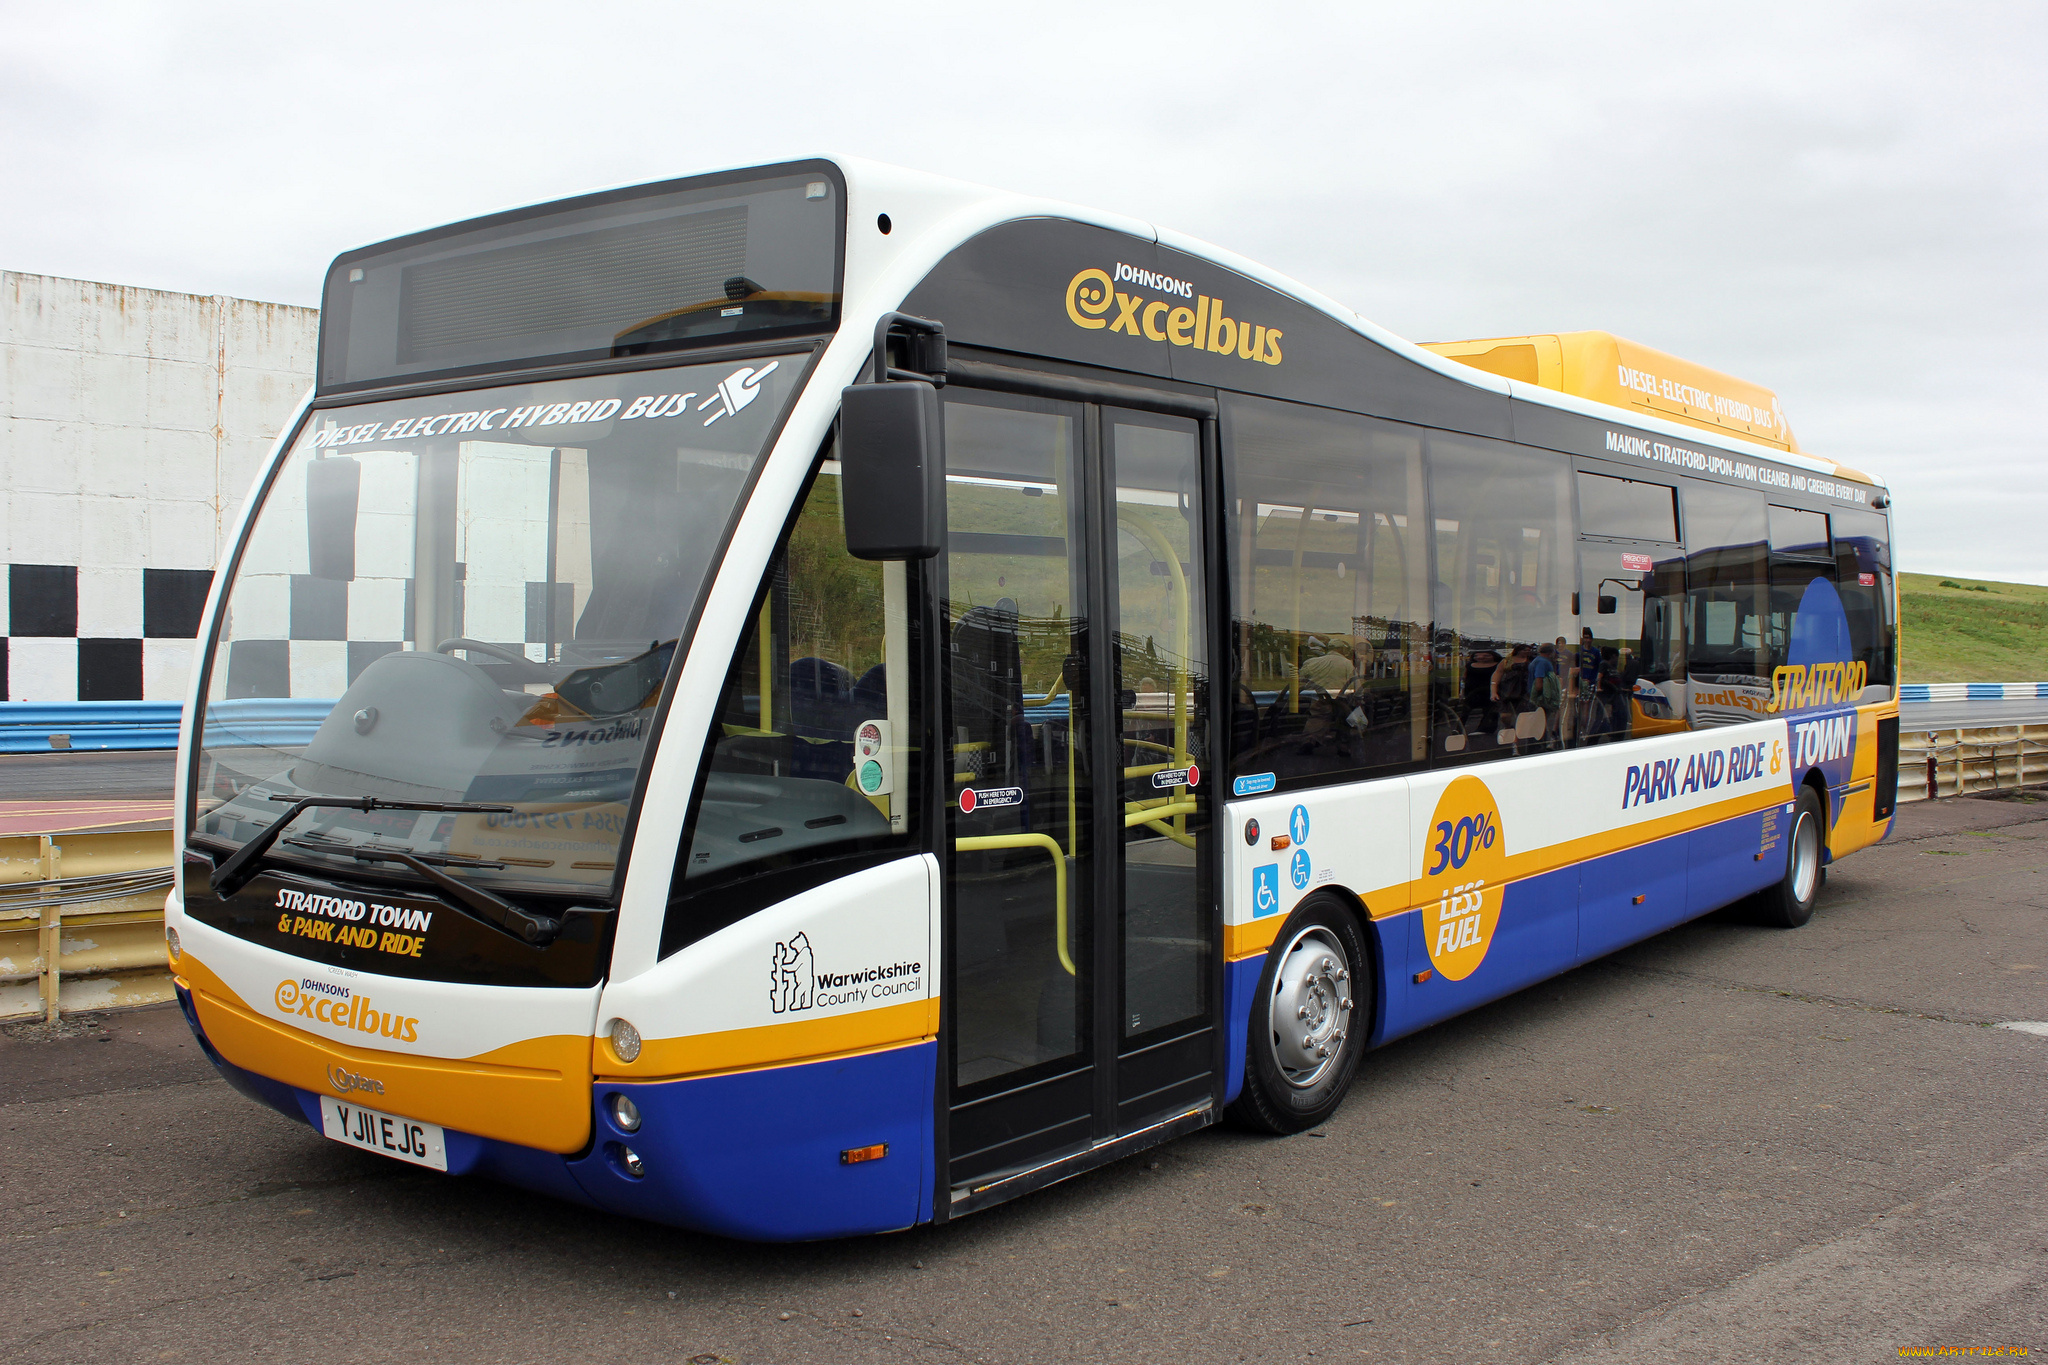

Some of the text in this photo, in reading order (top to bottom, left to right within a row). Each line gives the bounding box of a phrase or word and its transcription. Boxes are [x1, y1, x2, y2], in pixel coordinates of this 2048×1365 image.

[1114, 262, 1193, 299] JOHNSONS
[1618, 365, 1772, 429] DIESEL-ELECTRIC HYBRID BUS
[303, 392, 698, 450] DIESEL-ELECTRIC HYBRID BUS
[1606, 430, 1867, 504] MAKING STRATFORD-UPON-AVON CLEANER AND GREENER EVERY DAY
[1767, 660, 1867, 714] STRATFORD
[1794, 715, 1851, 769] TOWN
[1622, 739, 1784, 810] PARK AND RIDE &
[1427, 811, 1496, 876] 30%
[275, 888, 433, 932] STRATFORD TOWN
[1439, 879, 1485, 922] LESS
[277, 913, 426, 958] & PARK AND RIDE
[1434, 913, 1482, 958] FUEL
[300, 978, 350, 998] JOHNSONS
[816, 977, 921, 1007] County Council
[817, 961, 921, 990] Warwickshire
[333, 1066, 386, 1096] Optare
[337, 1105, 426, 1158] YJ11 EJG
